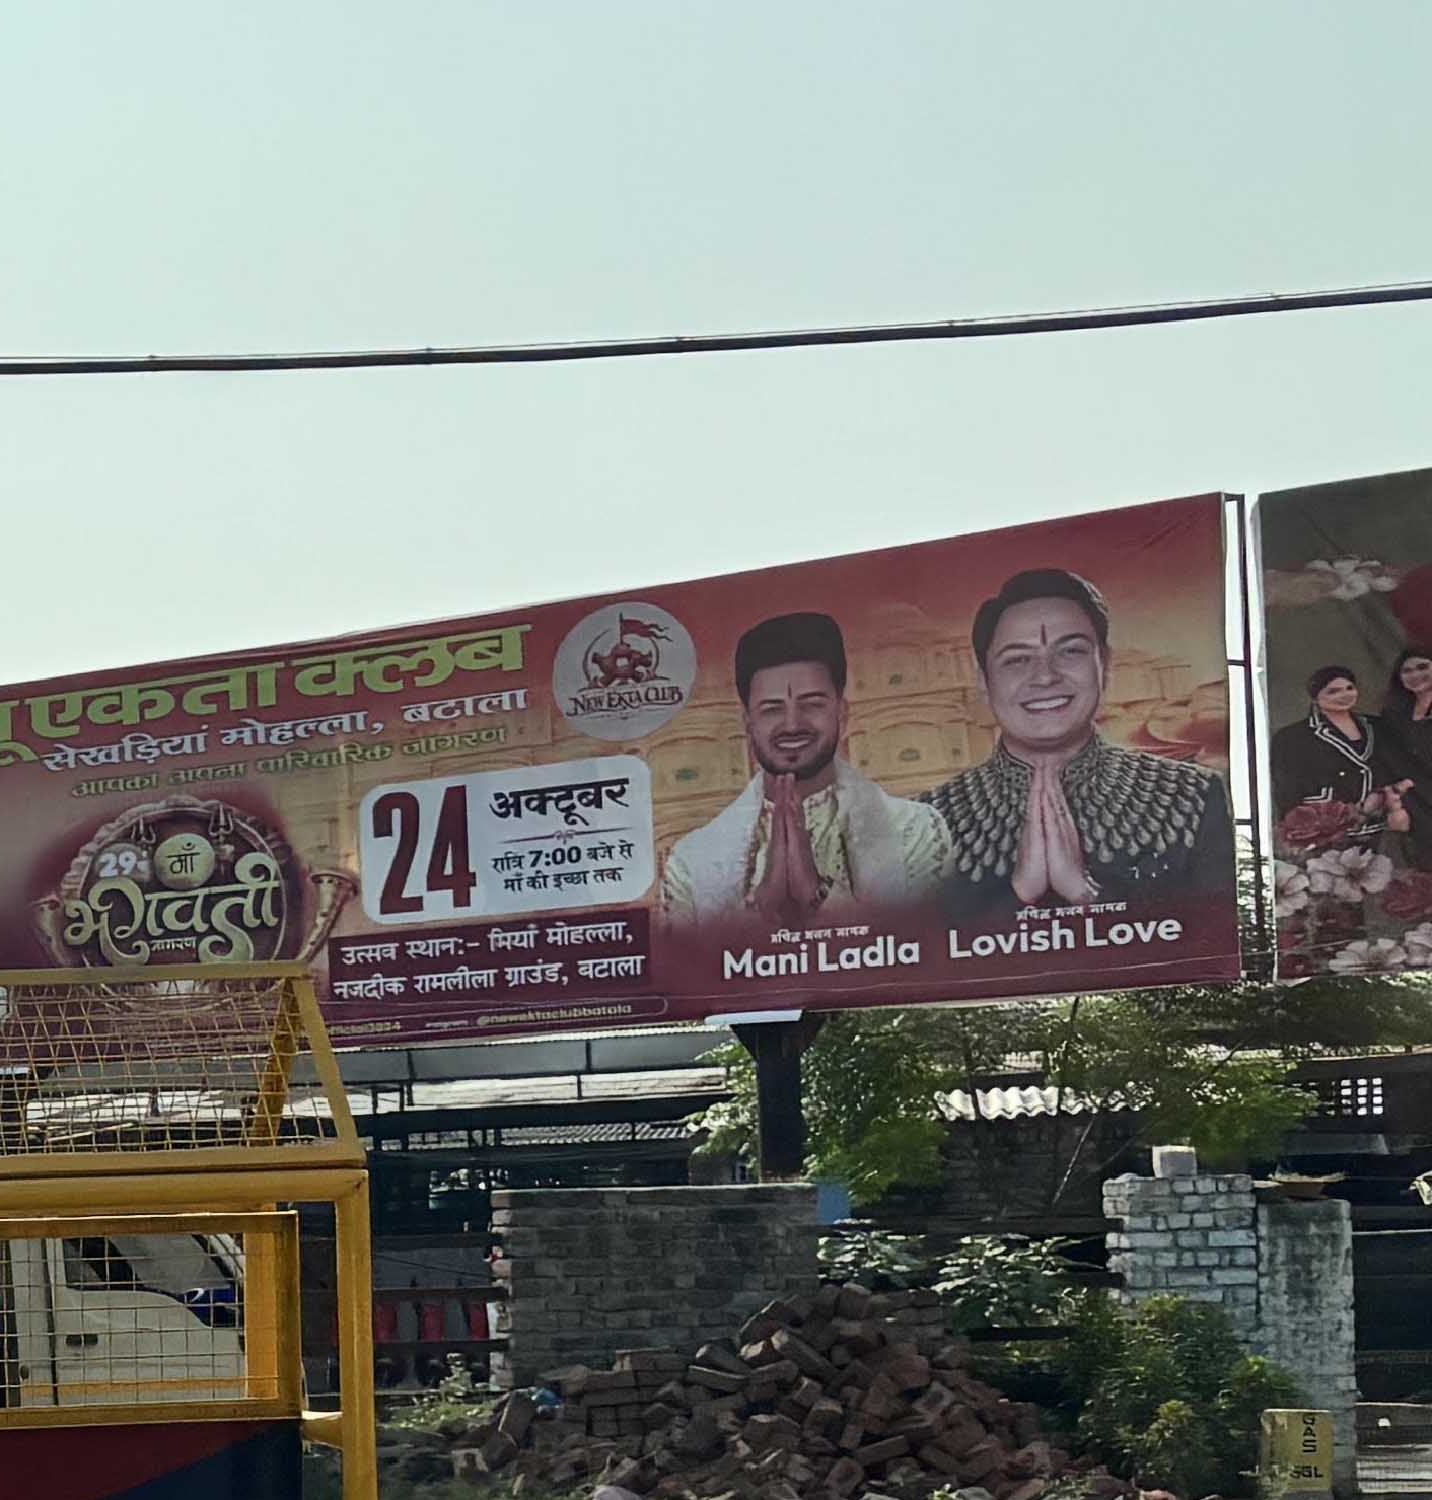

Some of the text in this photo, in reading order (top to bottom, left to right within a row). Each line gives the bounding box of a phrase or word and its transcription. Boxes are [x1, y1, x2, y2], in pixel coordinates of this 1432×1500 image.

[24, 661, 285, 738] एकता
[292, 624, 532, 697] क्लब
[220, 711, 384, 747] मोहल्ला,
[400, 688, 529, 723] बटाला
[167, 841, 201, 875] माँ
[372, 778, 630, 915] 24 अक्टूबर
[491, 840, 635, 874] रात्रि 7:00 बजे से
[527, 871, 550, 890] की
[553, 869, 589, 889] इच्छा
[593, 867, 624, 884] तक
[64, 851, 281, 965] भगवती
[341, 943, 399, 966] उत्सव
[546, 921, 633, 947] मोहल्ला,
[723, 935, 920, 979] Mani Ladla
[949, 917, 1183, 959] Lovish Love
[333, 973, 407, 999] नजदीक
[413, 966, 499, 993] रामलीला
[577, 955, 646, 979] बटाला
